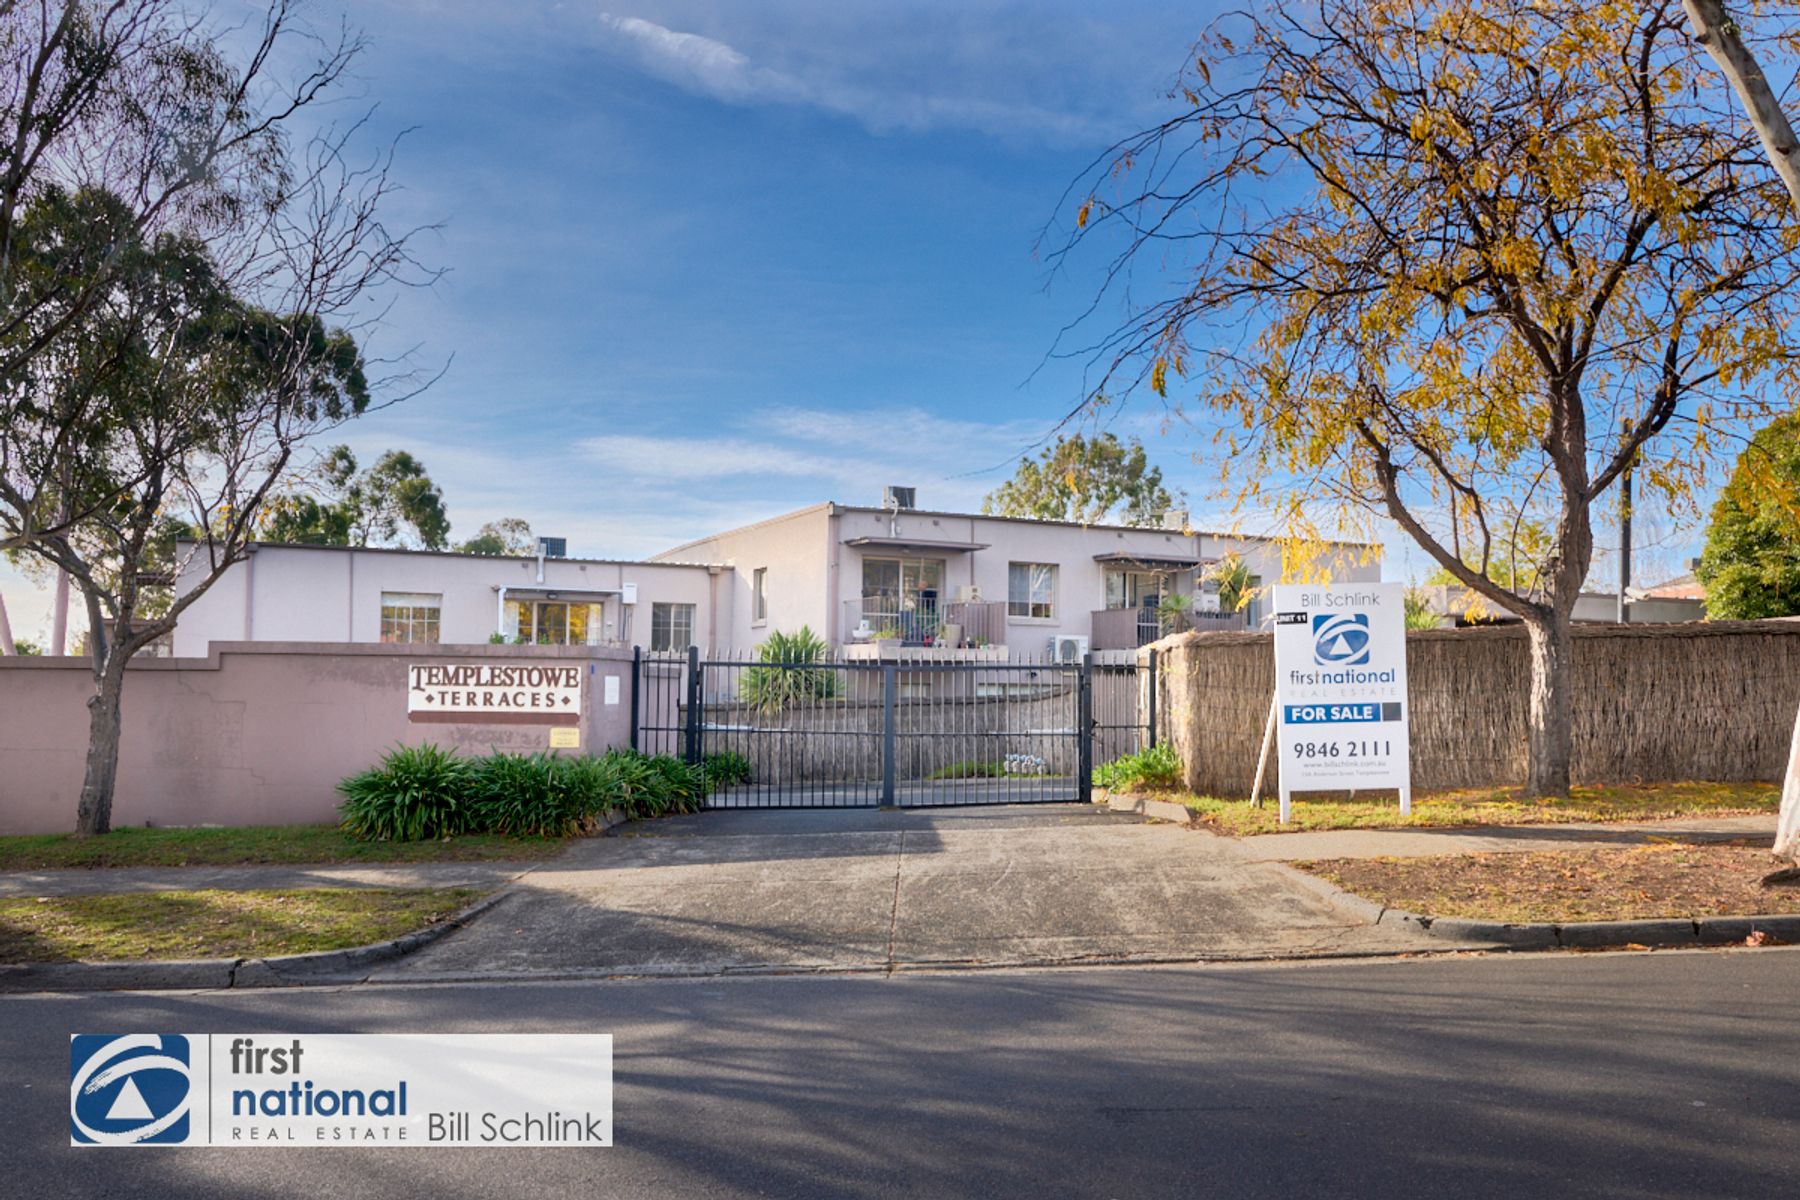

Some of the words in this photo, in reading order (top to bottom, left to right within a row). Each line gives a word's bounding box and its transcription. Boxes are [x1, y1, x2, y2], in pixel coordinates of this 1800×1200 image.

[1301, 593, 1320, 607] Bill
[1325, 592, 1380, 607] Schlink
[411, 666, 579, 691] TEMPLESTOWE
[1289, 670, 1320, 685] first
[1322, 668, 1395, 684] national
[438, 691, 555, 707] TERRACES
[1291, 707, 1327, 721] FOR
[1330, 706, 1373, 720] SALE
[1294, 742, 1340, 758] 9846
[1347, 740, 1390, 757] 2111
